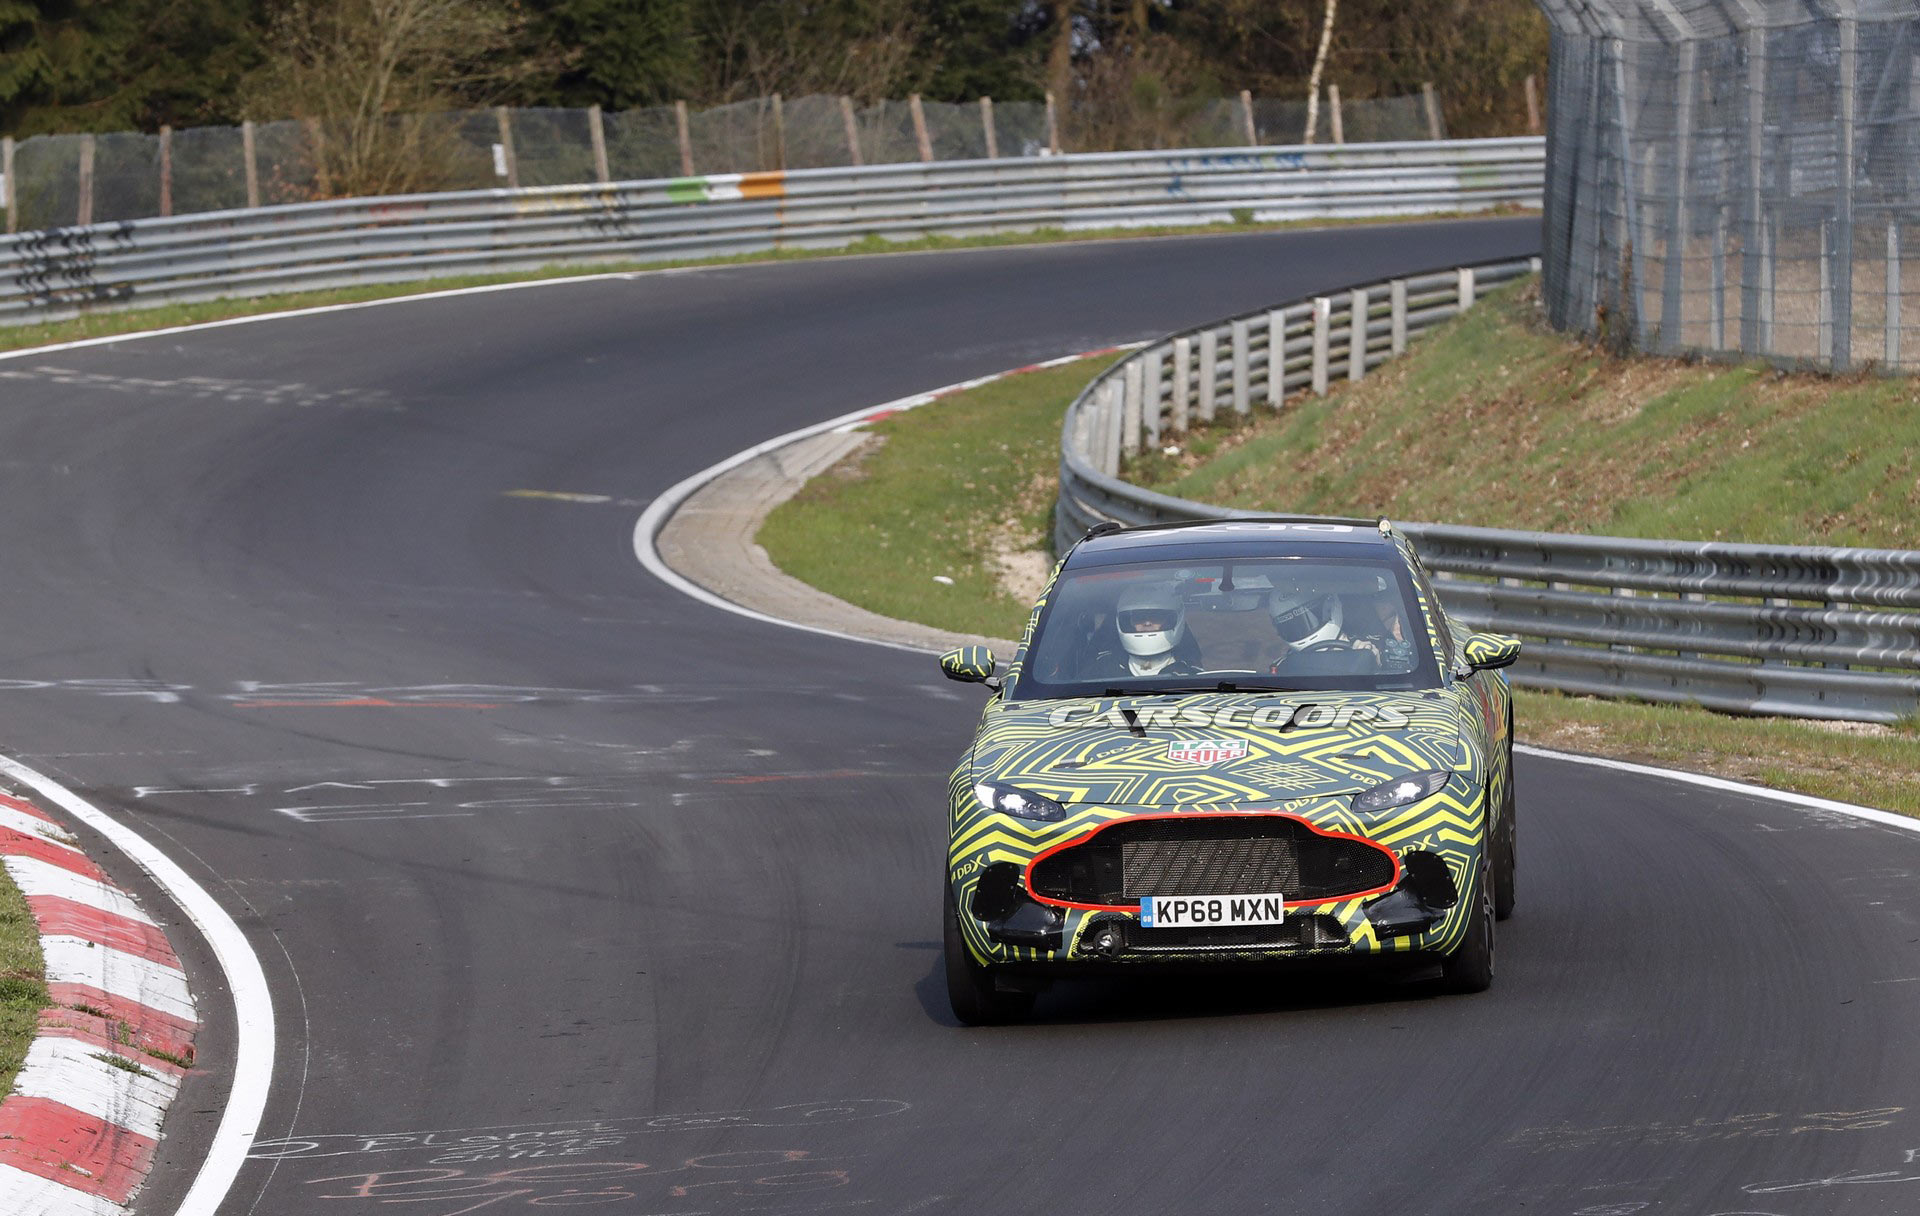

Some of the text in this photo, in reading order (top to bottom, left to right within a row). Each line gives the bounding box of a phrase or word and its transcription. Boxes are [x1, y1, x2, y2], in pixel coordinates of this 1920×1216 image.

[1176, 741, 1241, 750] TAG
[1172, 750, 1243, 764] HEUER
[1349, 773, 1383, 789] DB
[957, 853, 989, 880] DBX
[1157, 897, 1280, 924] KP68 MXN
